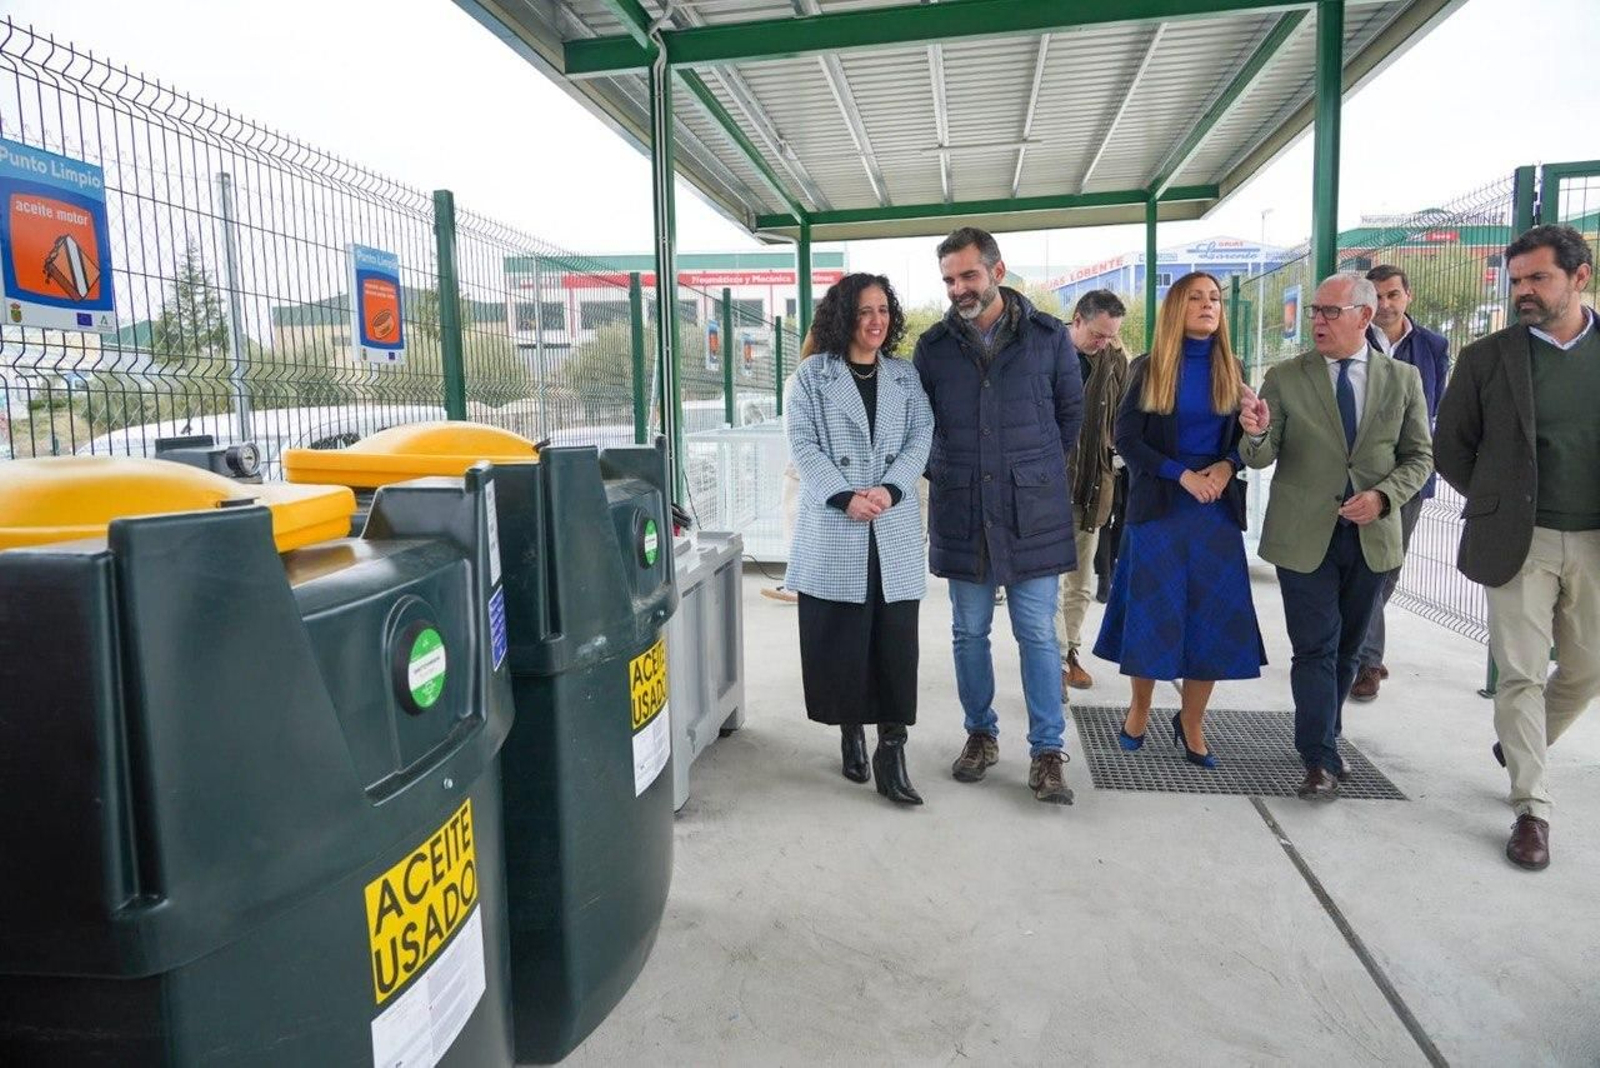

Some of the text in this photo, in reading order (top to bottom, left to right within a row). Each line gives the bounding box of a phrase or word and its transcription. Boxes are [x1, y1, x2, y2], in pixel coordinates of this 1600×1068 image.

[0, 146, 101, 188] Punto Limpio
[15, 200, 88, 226] aceite motor
[374, 805, 470, 936] ACEITE
[374, 859, 475, 994] USADO
